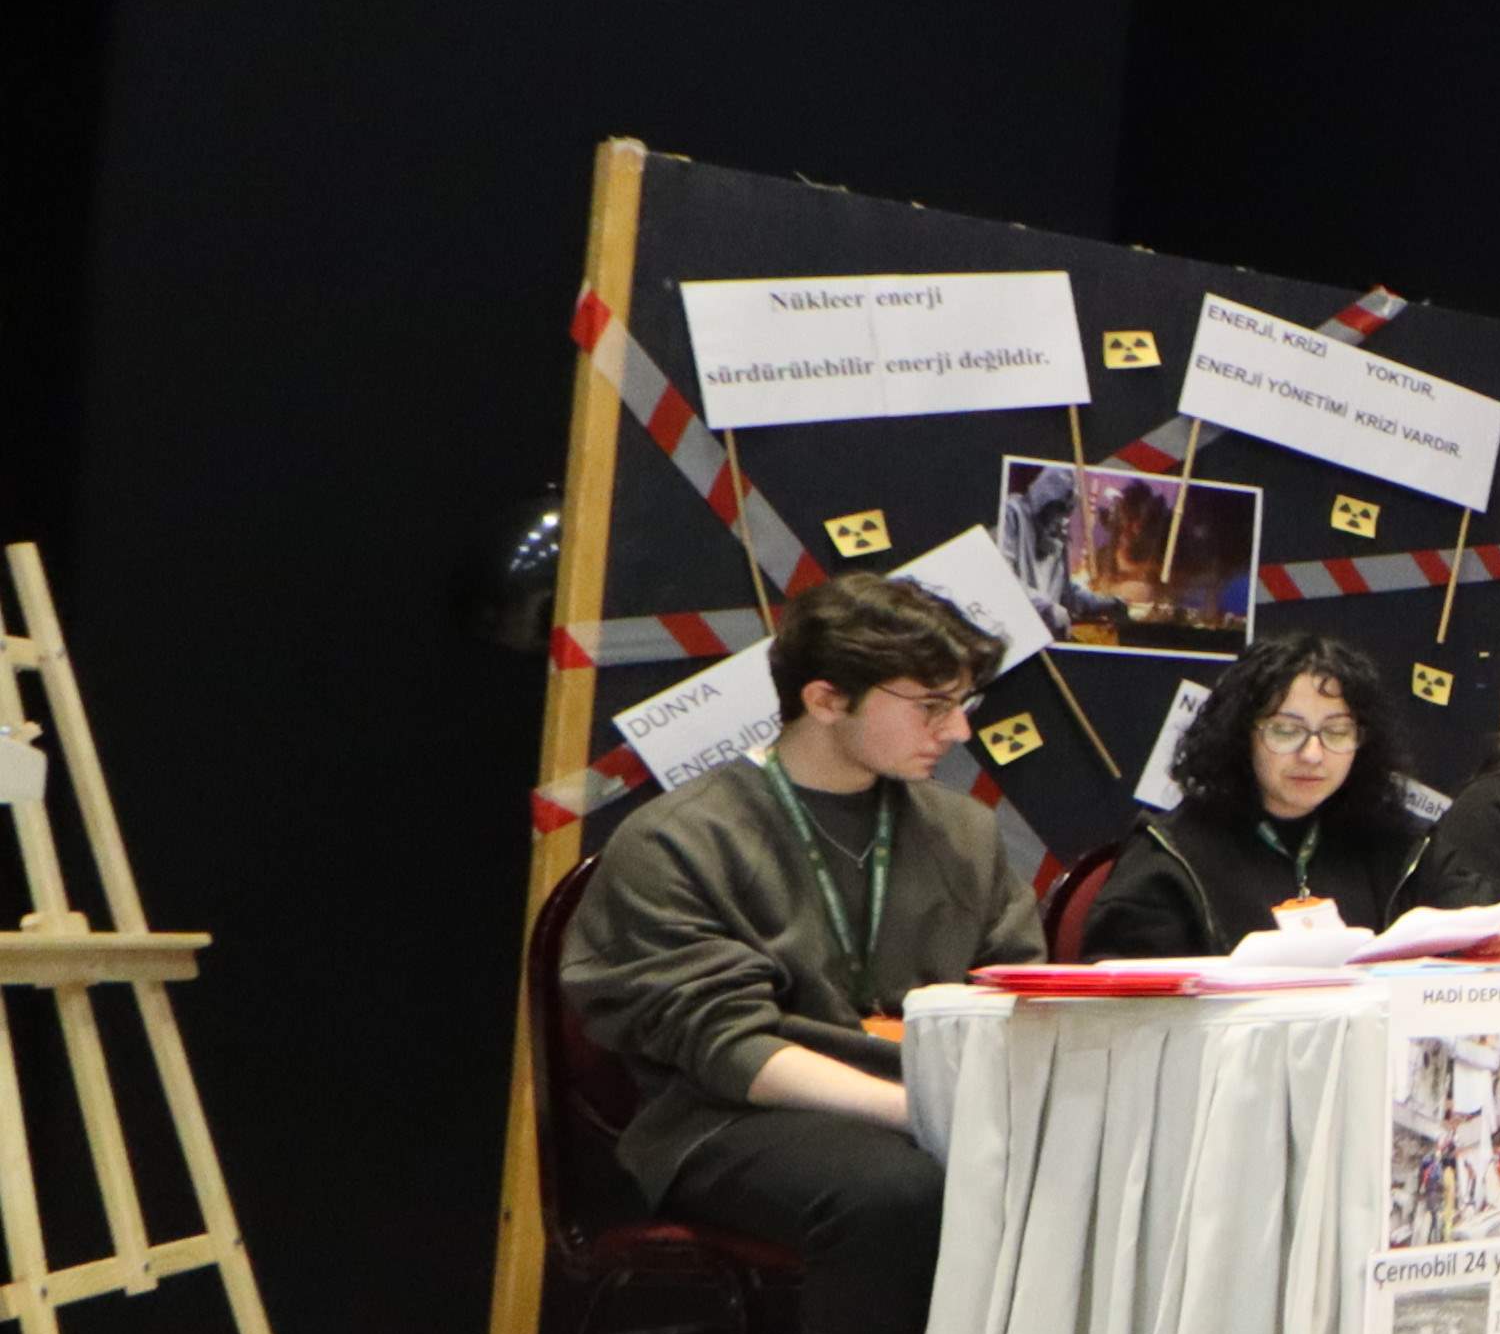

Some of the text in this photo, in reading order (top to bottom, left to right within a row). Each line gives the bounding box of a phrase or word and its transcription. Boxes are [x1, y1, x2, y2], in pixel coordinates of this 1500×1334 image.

[769, 287, 943, 313] Nükleer enerji
[1282, 330, 1329, 359] KRİZİ
[706, 347, 1051, 388] sürdürülebilir enerji değildir.
[1195, 354, 1463, 459] ENERJİ YÖNETİMİ KRİZİ VARDIR.
[626, 681, 724, 741] DÜNYA
[1422, 985, 1463, 1005] HADİ
[1373, 1253, 1458, 1290] Çernobil
[1464, 1252, 1487, 1272] 24
